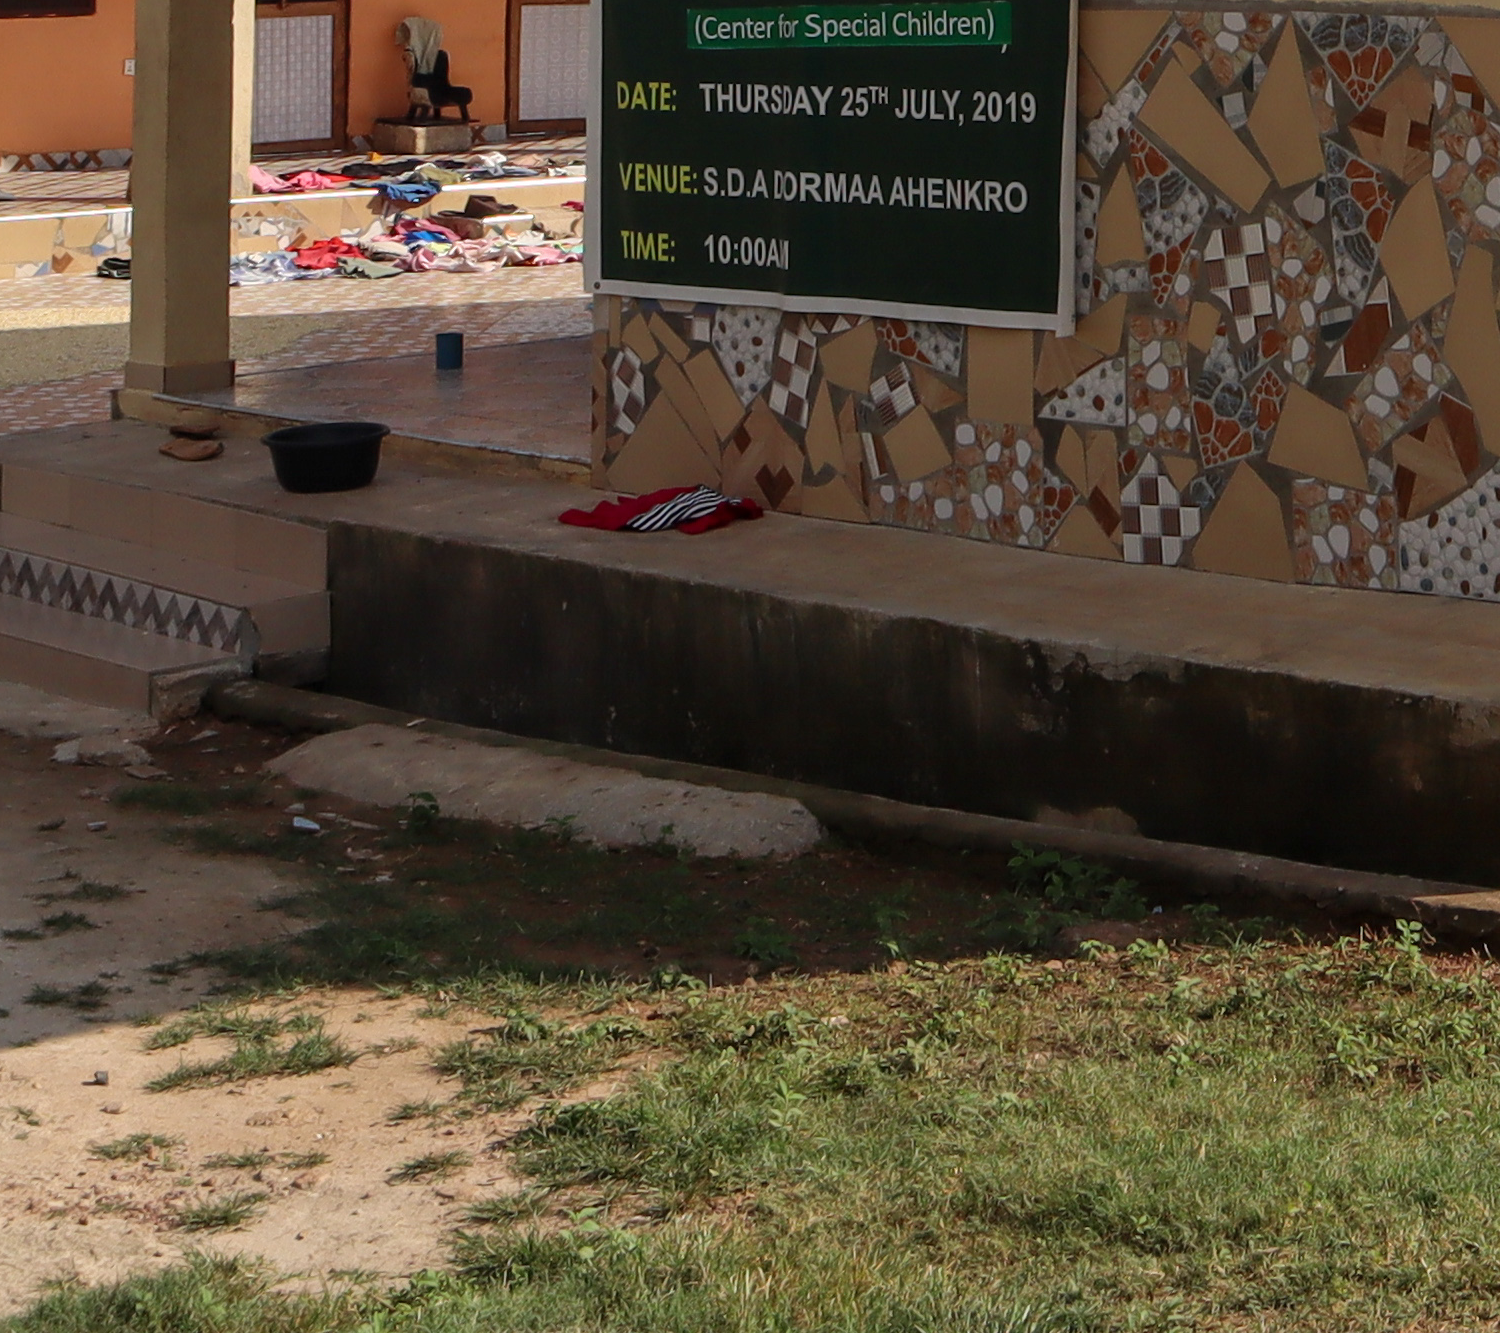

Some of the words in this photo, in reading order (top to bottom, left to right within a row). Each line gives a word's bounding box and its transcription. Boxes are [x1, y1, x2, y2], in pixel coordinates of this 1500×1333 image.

[694, 14, 775, 45] (Center
[778, 13, 799, 39] for
[804, 11, 887, 44] Special
[892, 8, 995, 41] Children)
[616, 81, 677, 112] DATE:
[699, 83, 834, 117] THURSDAY
[894, 88, 965, 127] JULY,
[972, 90, 1037, 124] 2019
[619, 162, 698, 195] VENUE:
[703, 166, 769, 199] S.D.A
[773, 169, 885, 206] DORMAA
[888, 175, 1029, 214] AHENKRO
[620, 230, 676, 263] TIME:
[703, 233, 789, 271] 10:00AM
